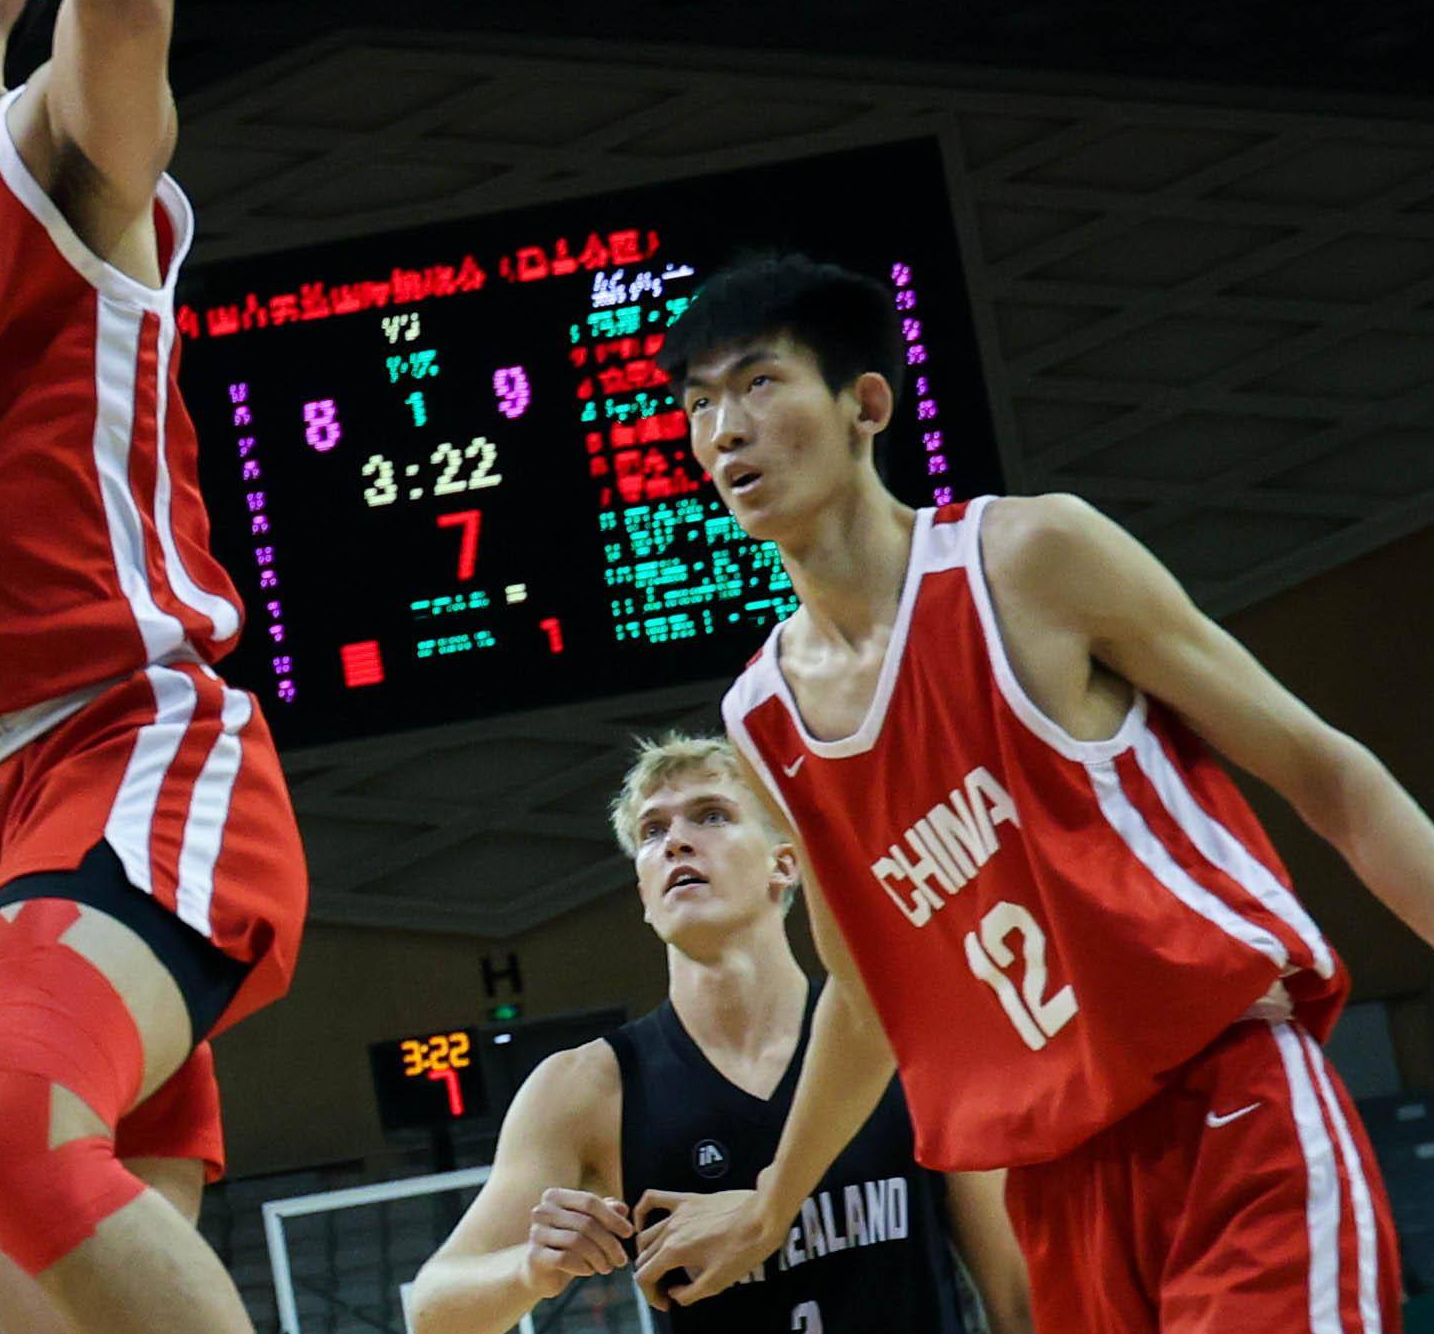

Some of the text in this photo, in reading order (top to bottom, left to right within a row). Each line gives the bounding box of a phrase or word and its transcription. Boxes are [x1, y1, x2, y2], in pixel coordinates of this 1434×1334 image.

[404, 391, 428, 427] 1
[493, 365, 531, 419] 9
[303, 398, 342, 452] 8
[361, 436, 503, 507] 3:22
[436, 509, 483, 582] 7
[539, 617, 564, 655] 1
[870, 765, 1022, 928] CHINA
[963, 900, 1081, 1052] 12
[400, 1031, 470, 1077] 3:22
[428, 1067, 465, 1116] 7
